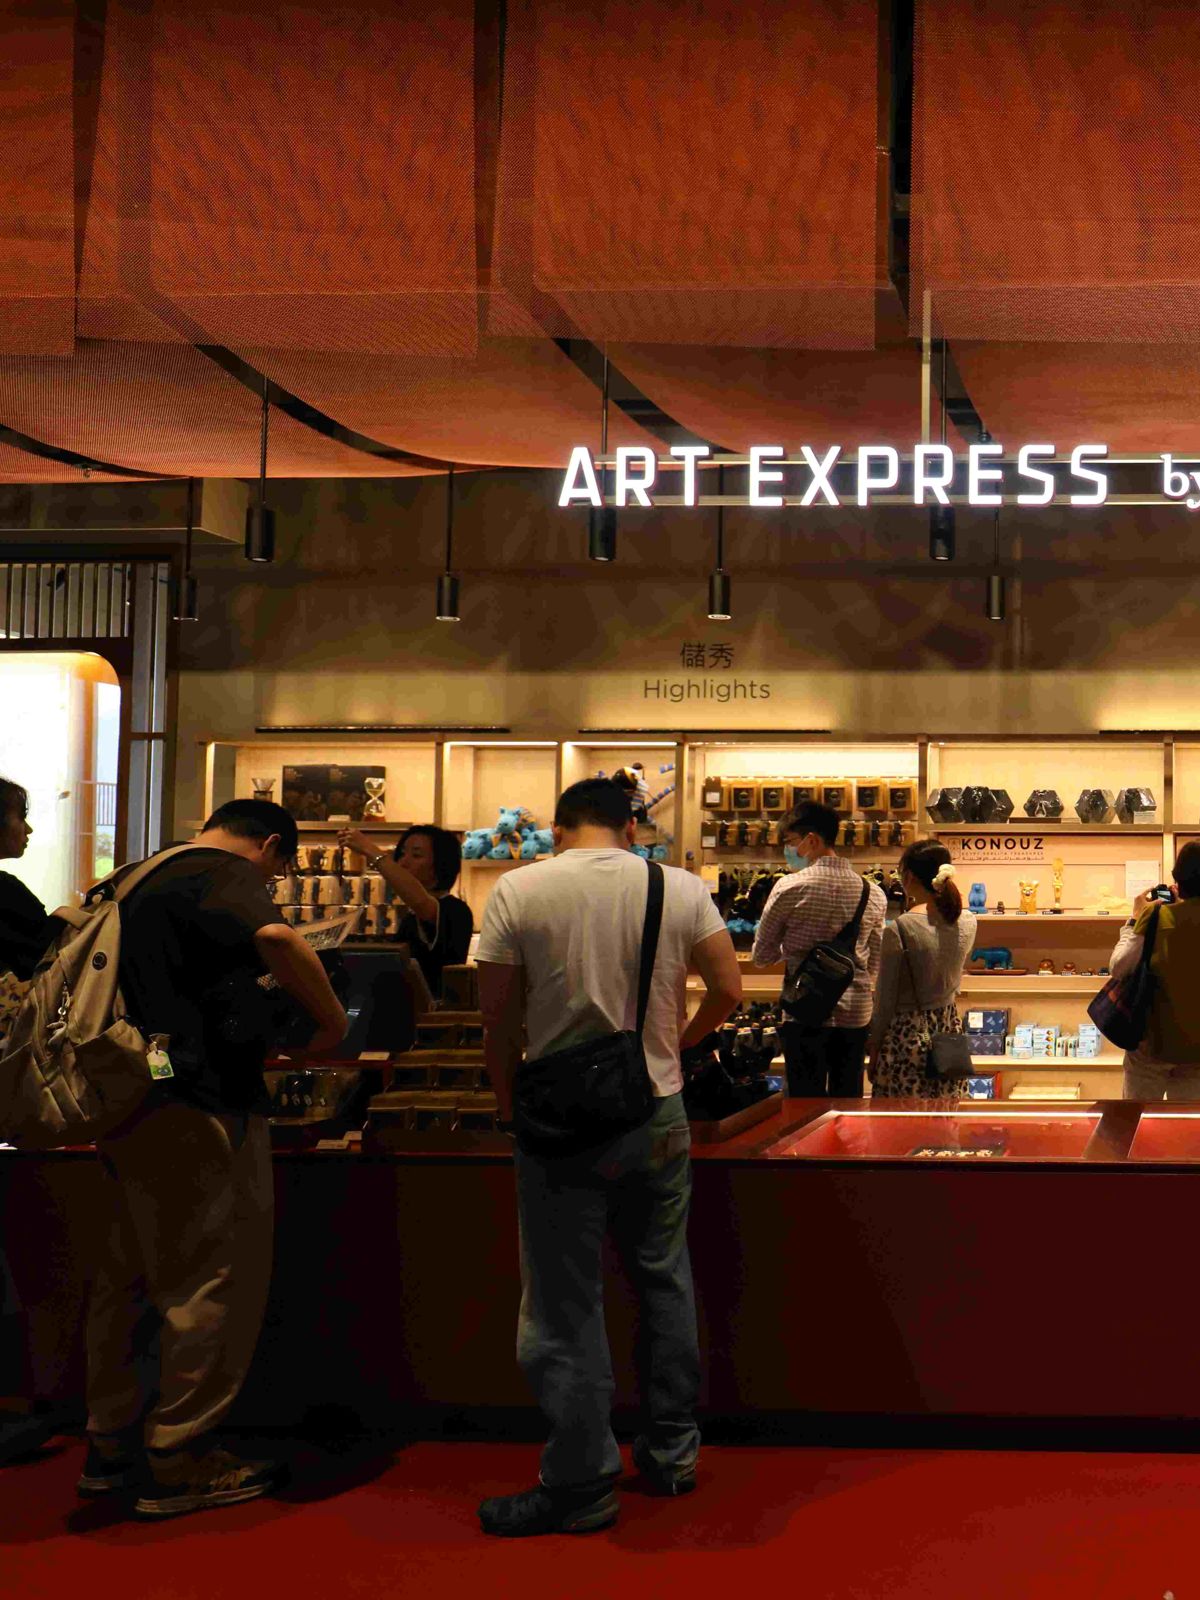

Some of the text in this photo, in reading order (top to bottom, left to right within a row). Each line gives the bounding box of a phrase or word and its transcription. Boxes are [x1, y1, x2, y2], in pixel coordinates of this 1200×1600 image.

[558, 445, 711, 507] ART
[742, 444, 1109, 507] EXPRESS
[680, 642, 735, 669] 儲秀
[643, 679, 771, 703] Highlights
[961, 837, 1044, 850] KONOUZ
